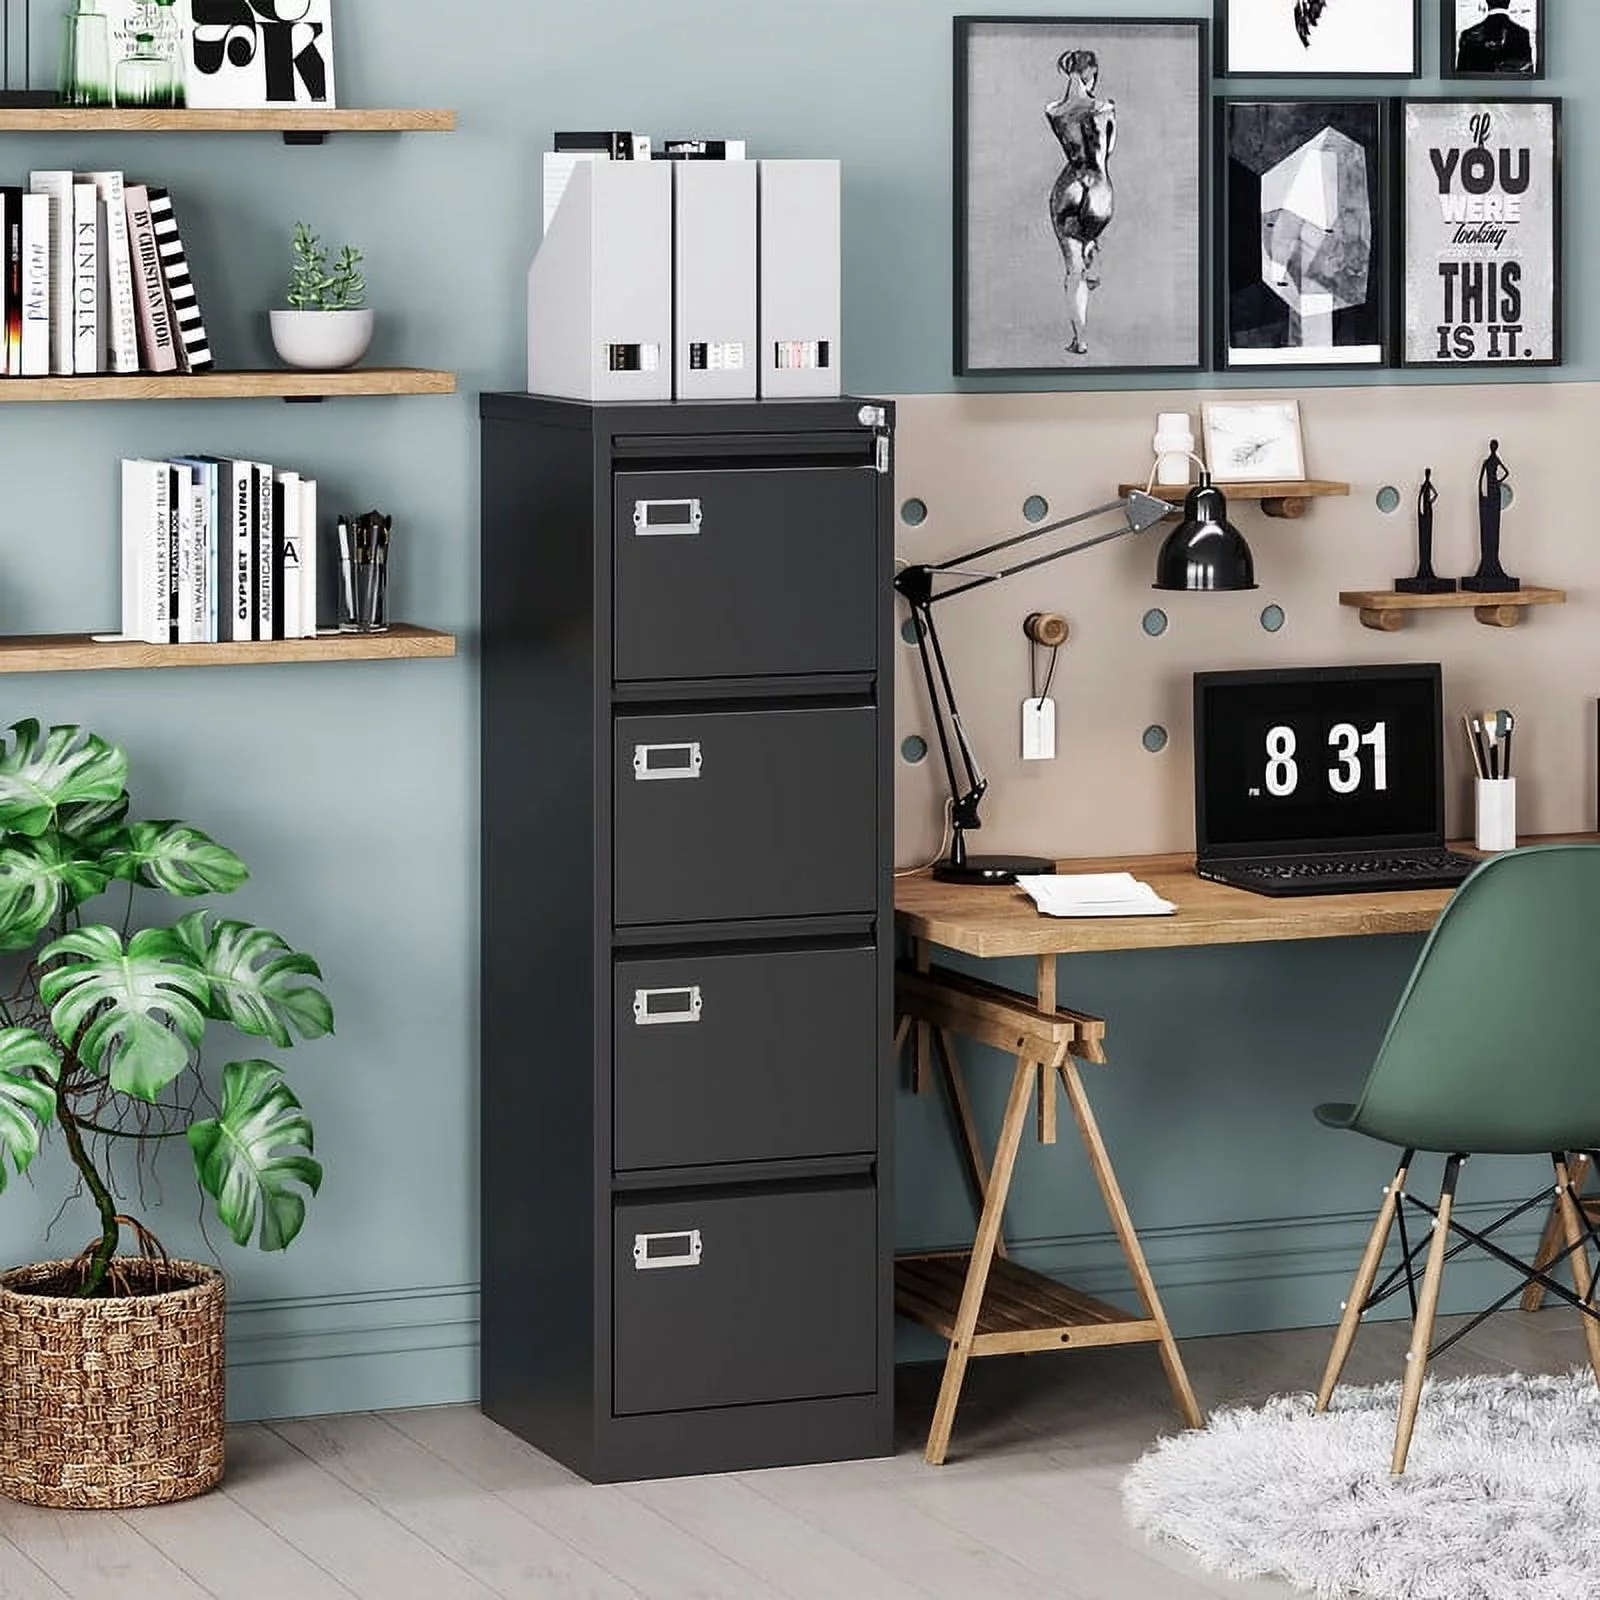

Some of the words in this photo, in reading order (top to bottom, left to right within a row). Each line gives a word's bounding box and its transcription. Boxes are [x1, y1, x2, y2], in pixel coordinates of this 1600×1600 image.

[1429, 148, 1530, 194] YOU
[134, 210, 149, 228] BY
[1440, 194, 1520, 222] WERE
[1452, 222, 1507, 250] looking
[79, 223, 95, 337] KINFOLK
[138, 232, 163, 308] CHRISTIAN
[1438, 261, 1521, 323] THIS
[152, 311, 170, 347] DIOR
[1437, 325, 1475, 359] IS
[1487, 325, 1532, 358] IT.
[156, 511, 167, 548] STORY
[238, 479, 247, 537] LIVING
[262, 476, 270, 539] FASHION
[156, 551, 167, 598] WALKER
[194, 565, 203, 603] WALKER
[262, 543, 270, 622] AMERICAN
[156, 602, 167, 621] TIM
[1265, 725, 1298, 796] 8
[1328, 721, 1387, 793] 31
